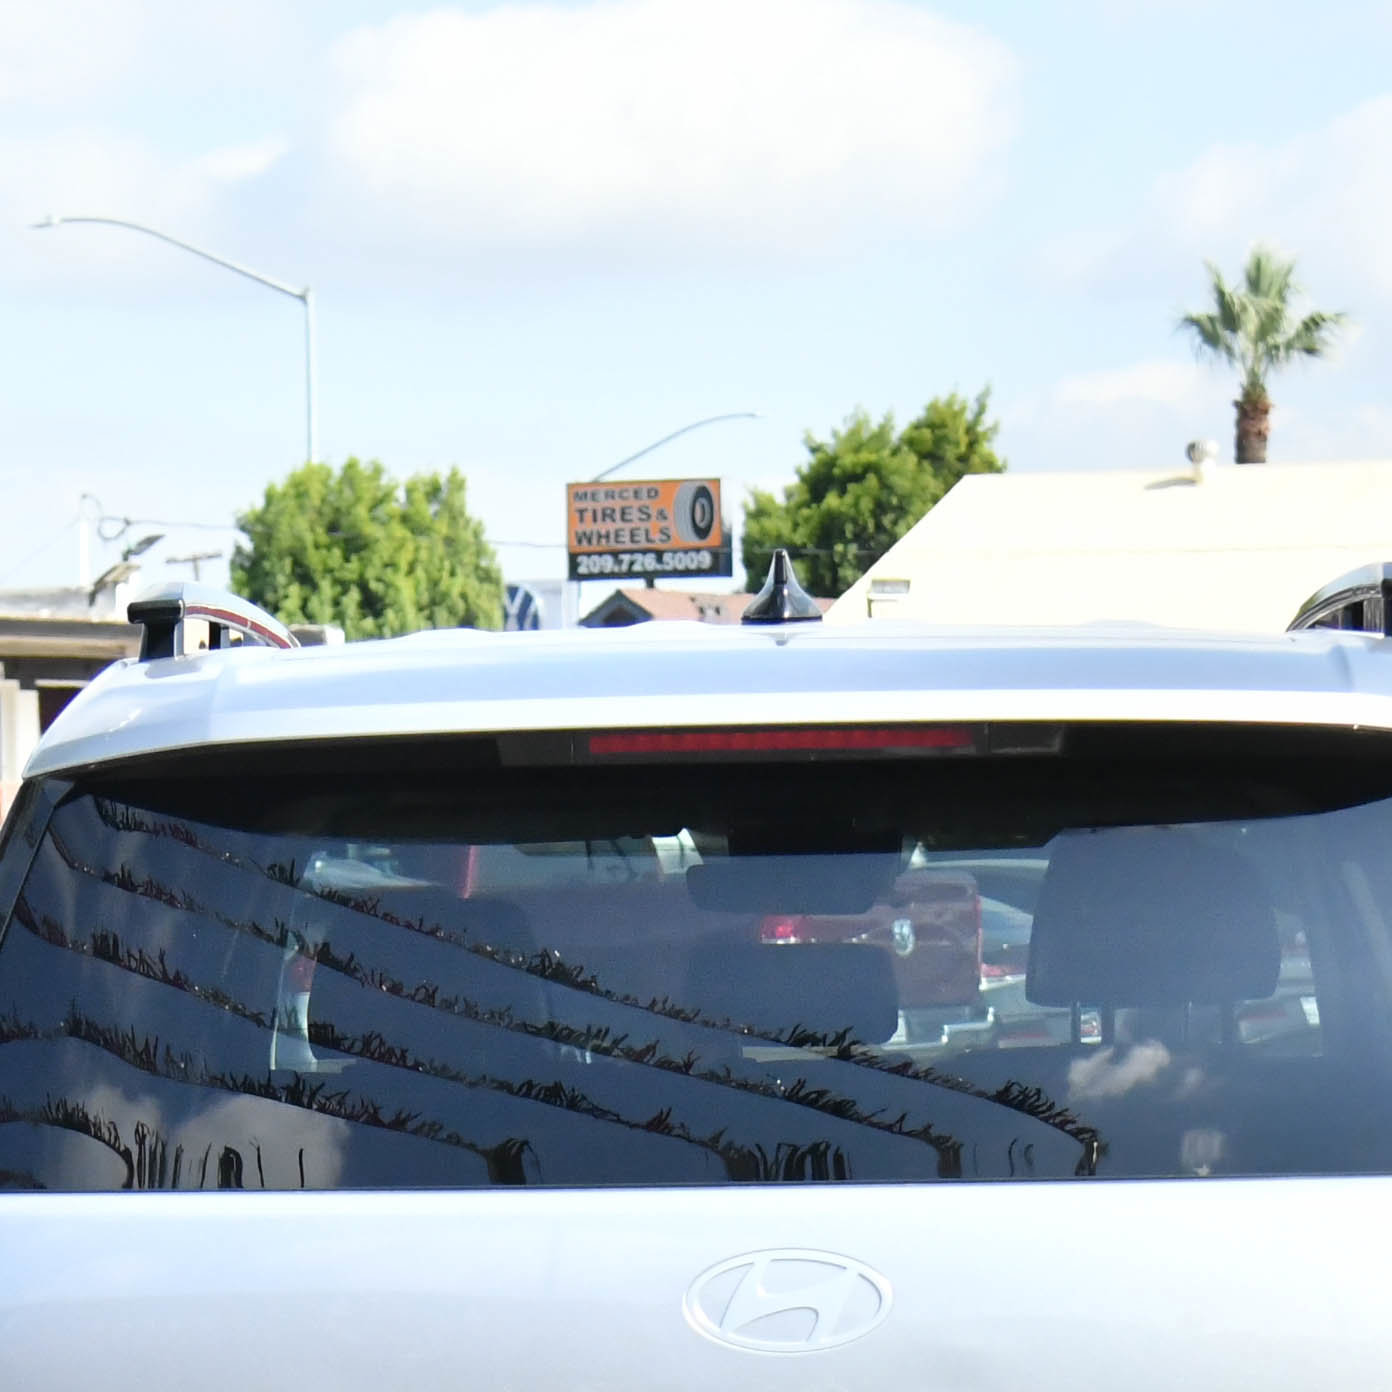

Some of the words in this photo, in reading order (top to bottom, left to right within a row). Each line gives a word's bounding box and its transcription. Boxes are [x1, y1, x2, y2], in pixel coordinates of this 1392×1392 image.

[574, 488, 659, 502] MERCED
[576, 506, 652, 523] TIRES
[655, 509, 669, 522] &
[575, 527, 671, 546] WHEELS
[576, 551, 711, 574] 209.726.5009
